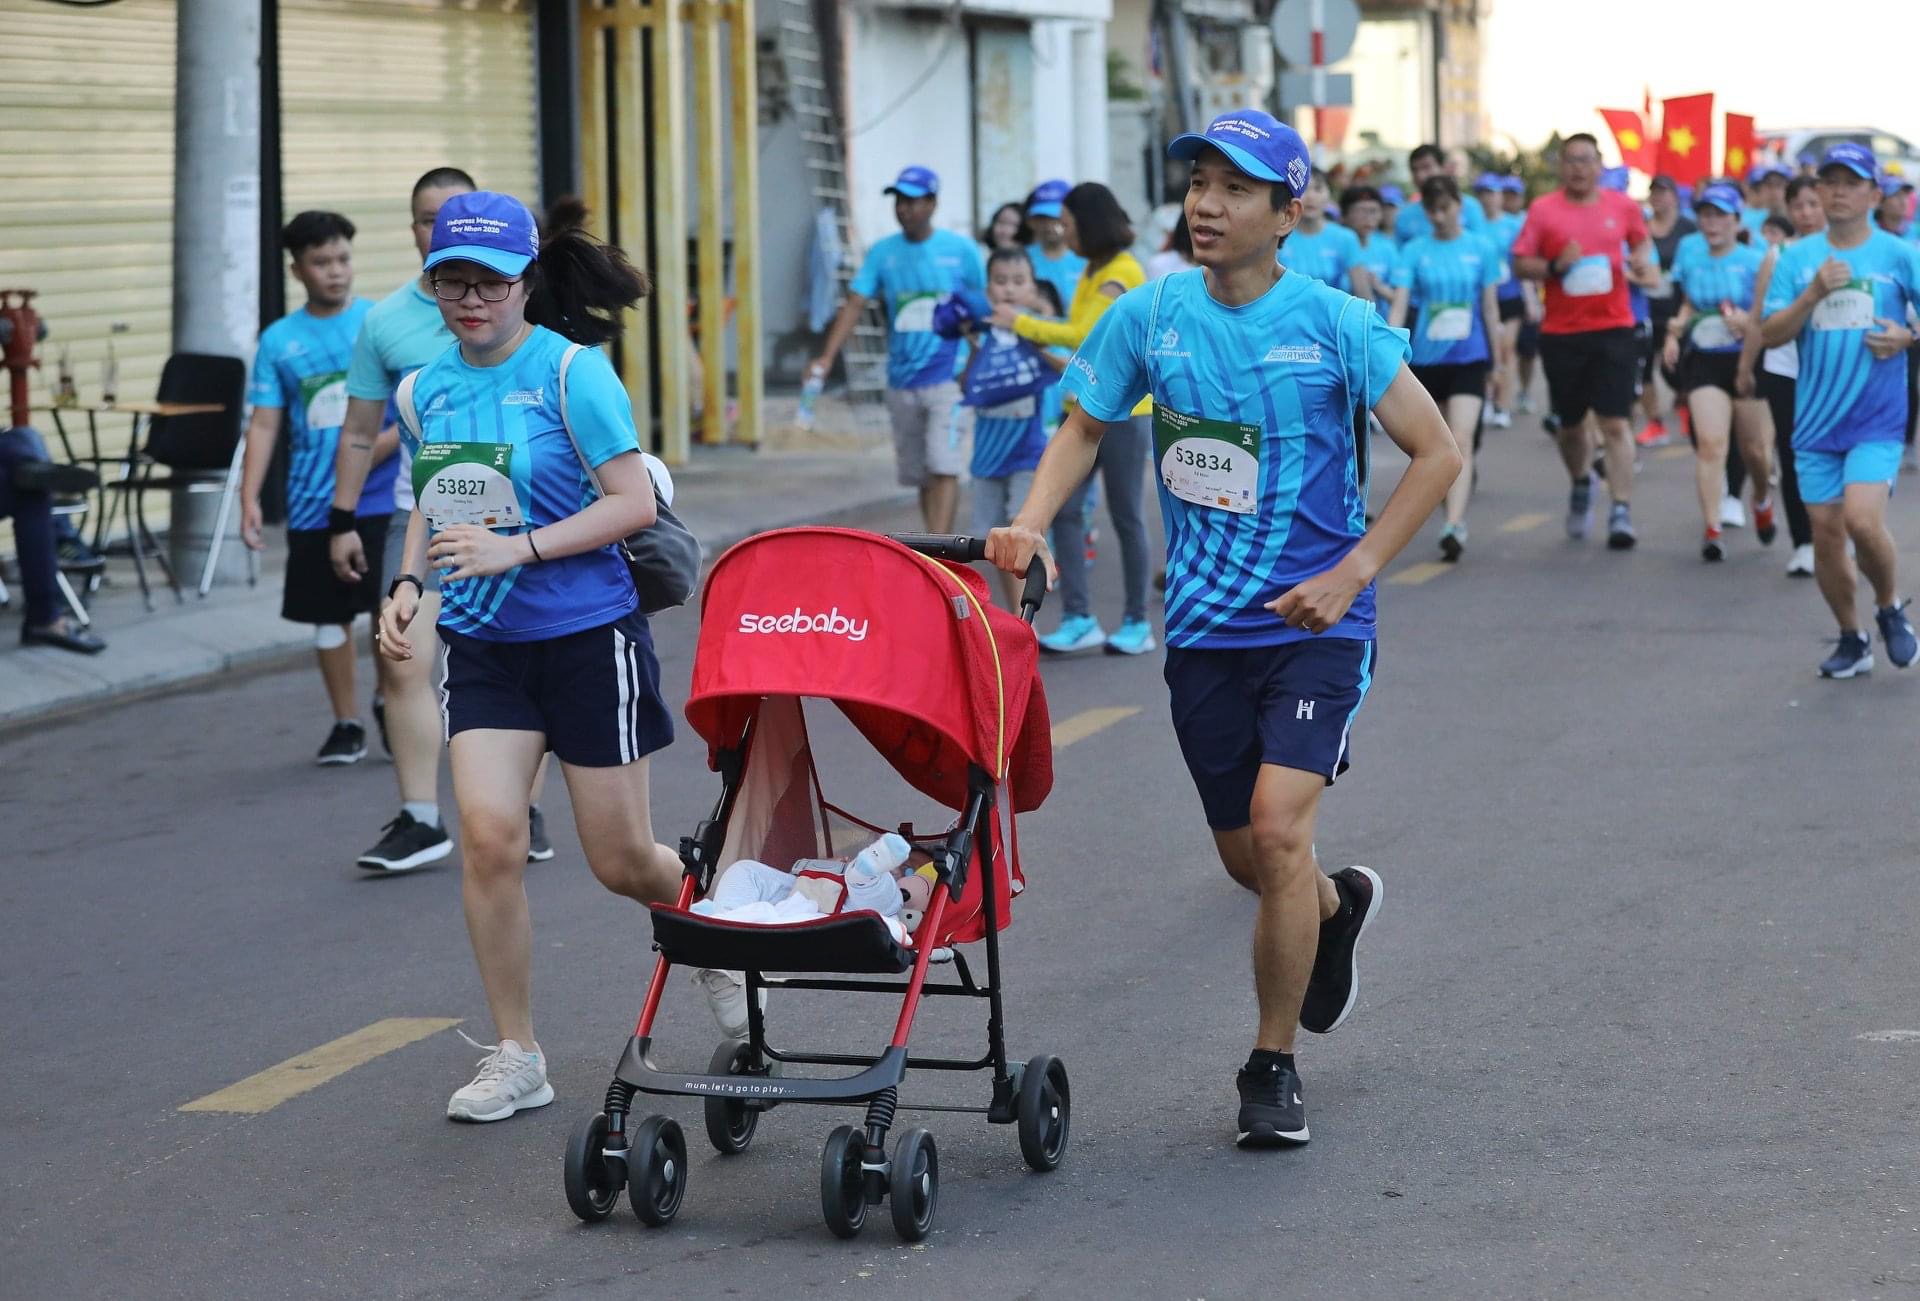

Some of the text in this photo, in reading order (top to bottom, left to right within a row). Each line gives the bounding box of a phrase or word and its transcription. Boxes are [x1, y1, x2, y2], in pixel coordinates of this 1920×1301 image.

[1241, 128, 1259, 140] 2020
[1176, 446, 1233, 473] 53834
[437, 478, 486, 496] 53827
[739, 606, 868, 641] seebaby
[735, 1085, 748, 1094] go
[750, 1084, 760, 1092] to
